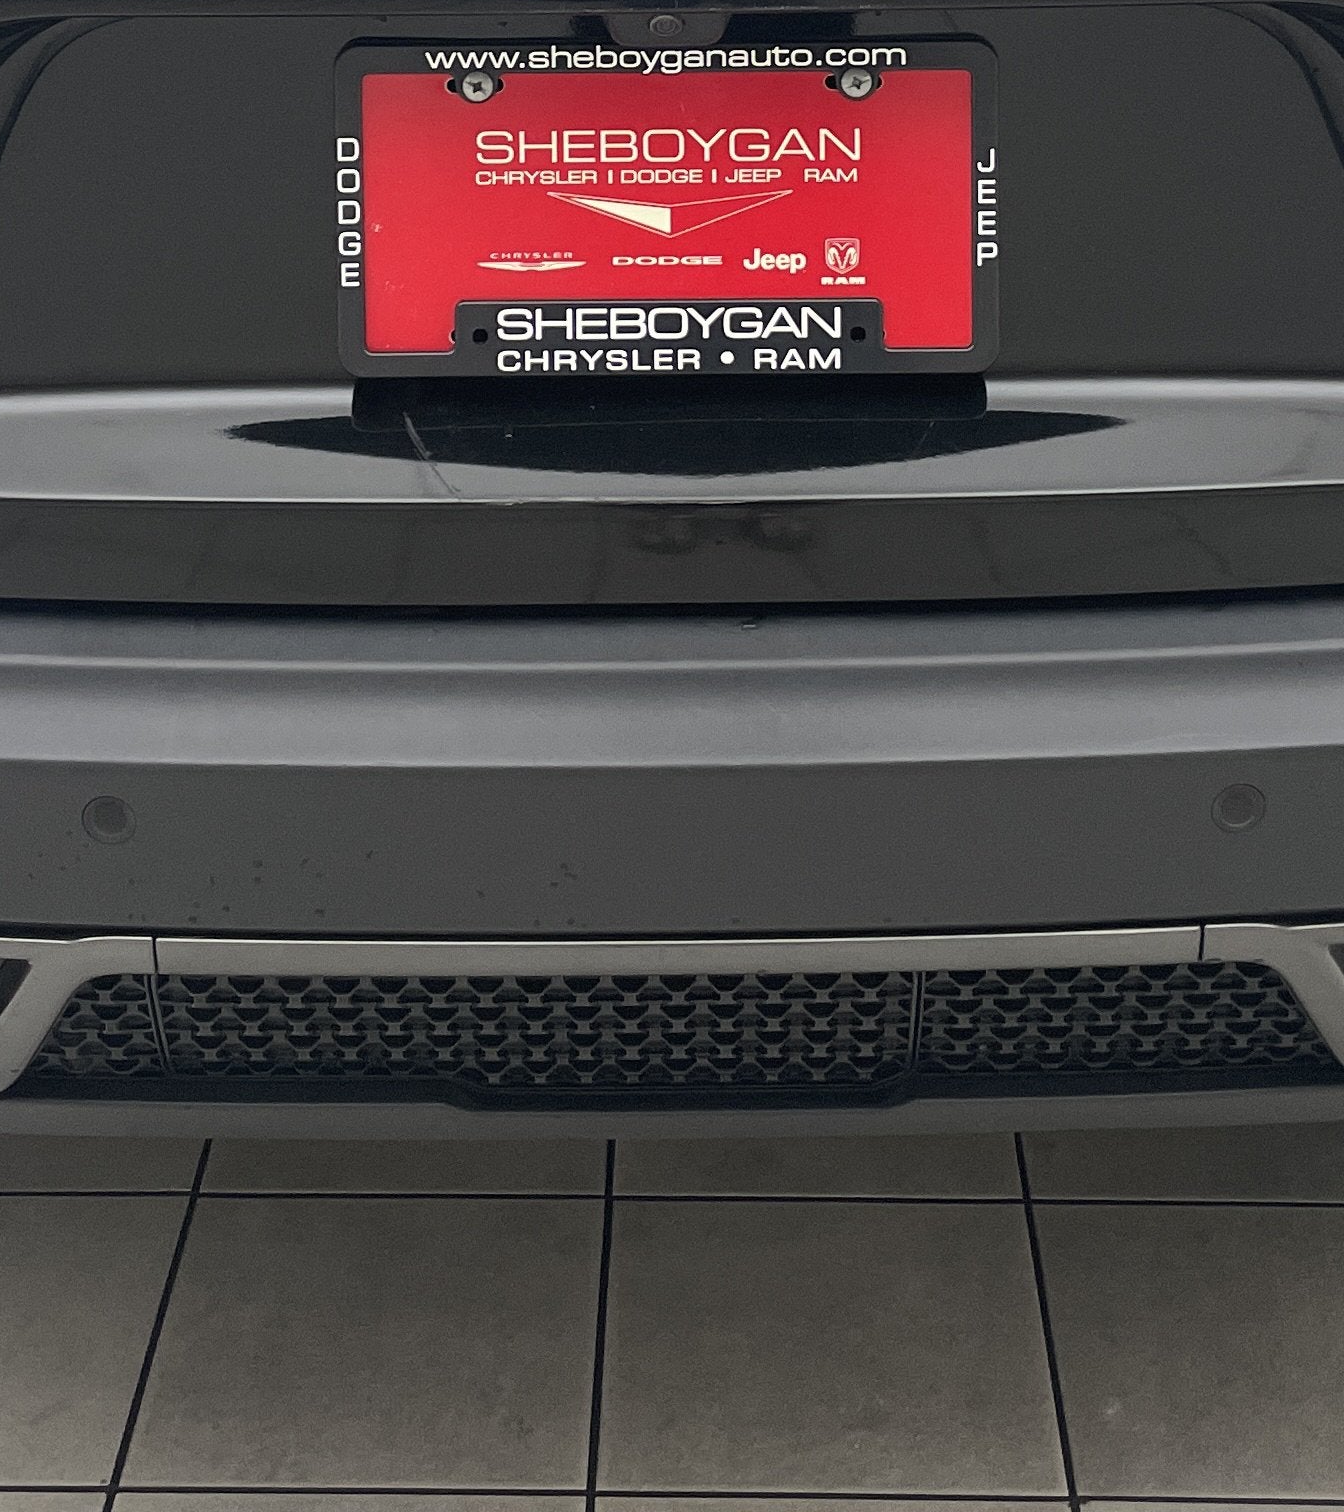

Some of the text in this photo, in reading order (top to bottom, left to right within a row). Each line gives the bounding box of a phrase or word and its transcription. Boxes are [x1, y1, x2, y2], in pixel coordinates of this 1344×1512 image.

[425, 44, 908, 75] www.sheboyganauto.com
[475, 128, 861, 165] SHEBOYGAN
[475, 169, 858, 186] CHRYSLER DODGE JEEP RAM
[336, 137, 361, 288] DODGE
[976, 148, 999, 267] JEEP
[490, 251, 574, 259] CHRYSLER
[612, 255, 723, 266] DODGE
[743, 248, 807, 274] Jeep
[821, 276, 866, 285] RAM
[496, 306, 841, 341] SHEBOYGAN
[497, 348, 841, 372] CHRYSLER RAM
